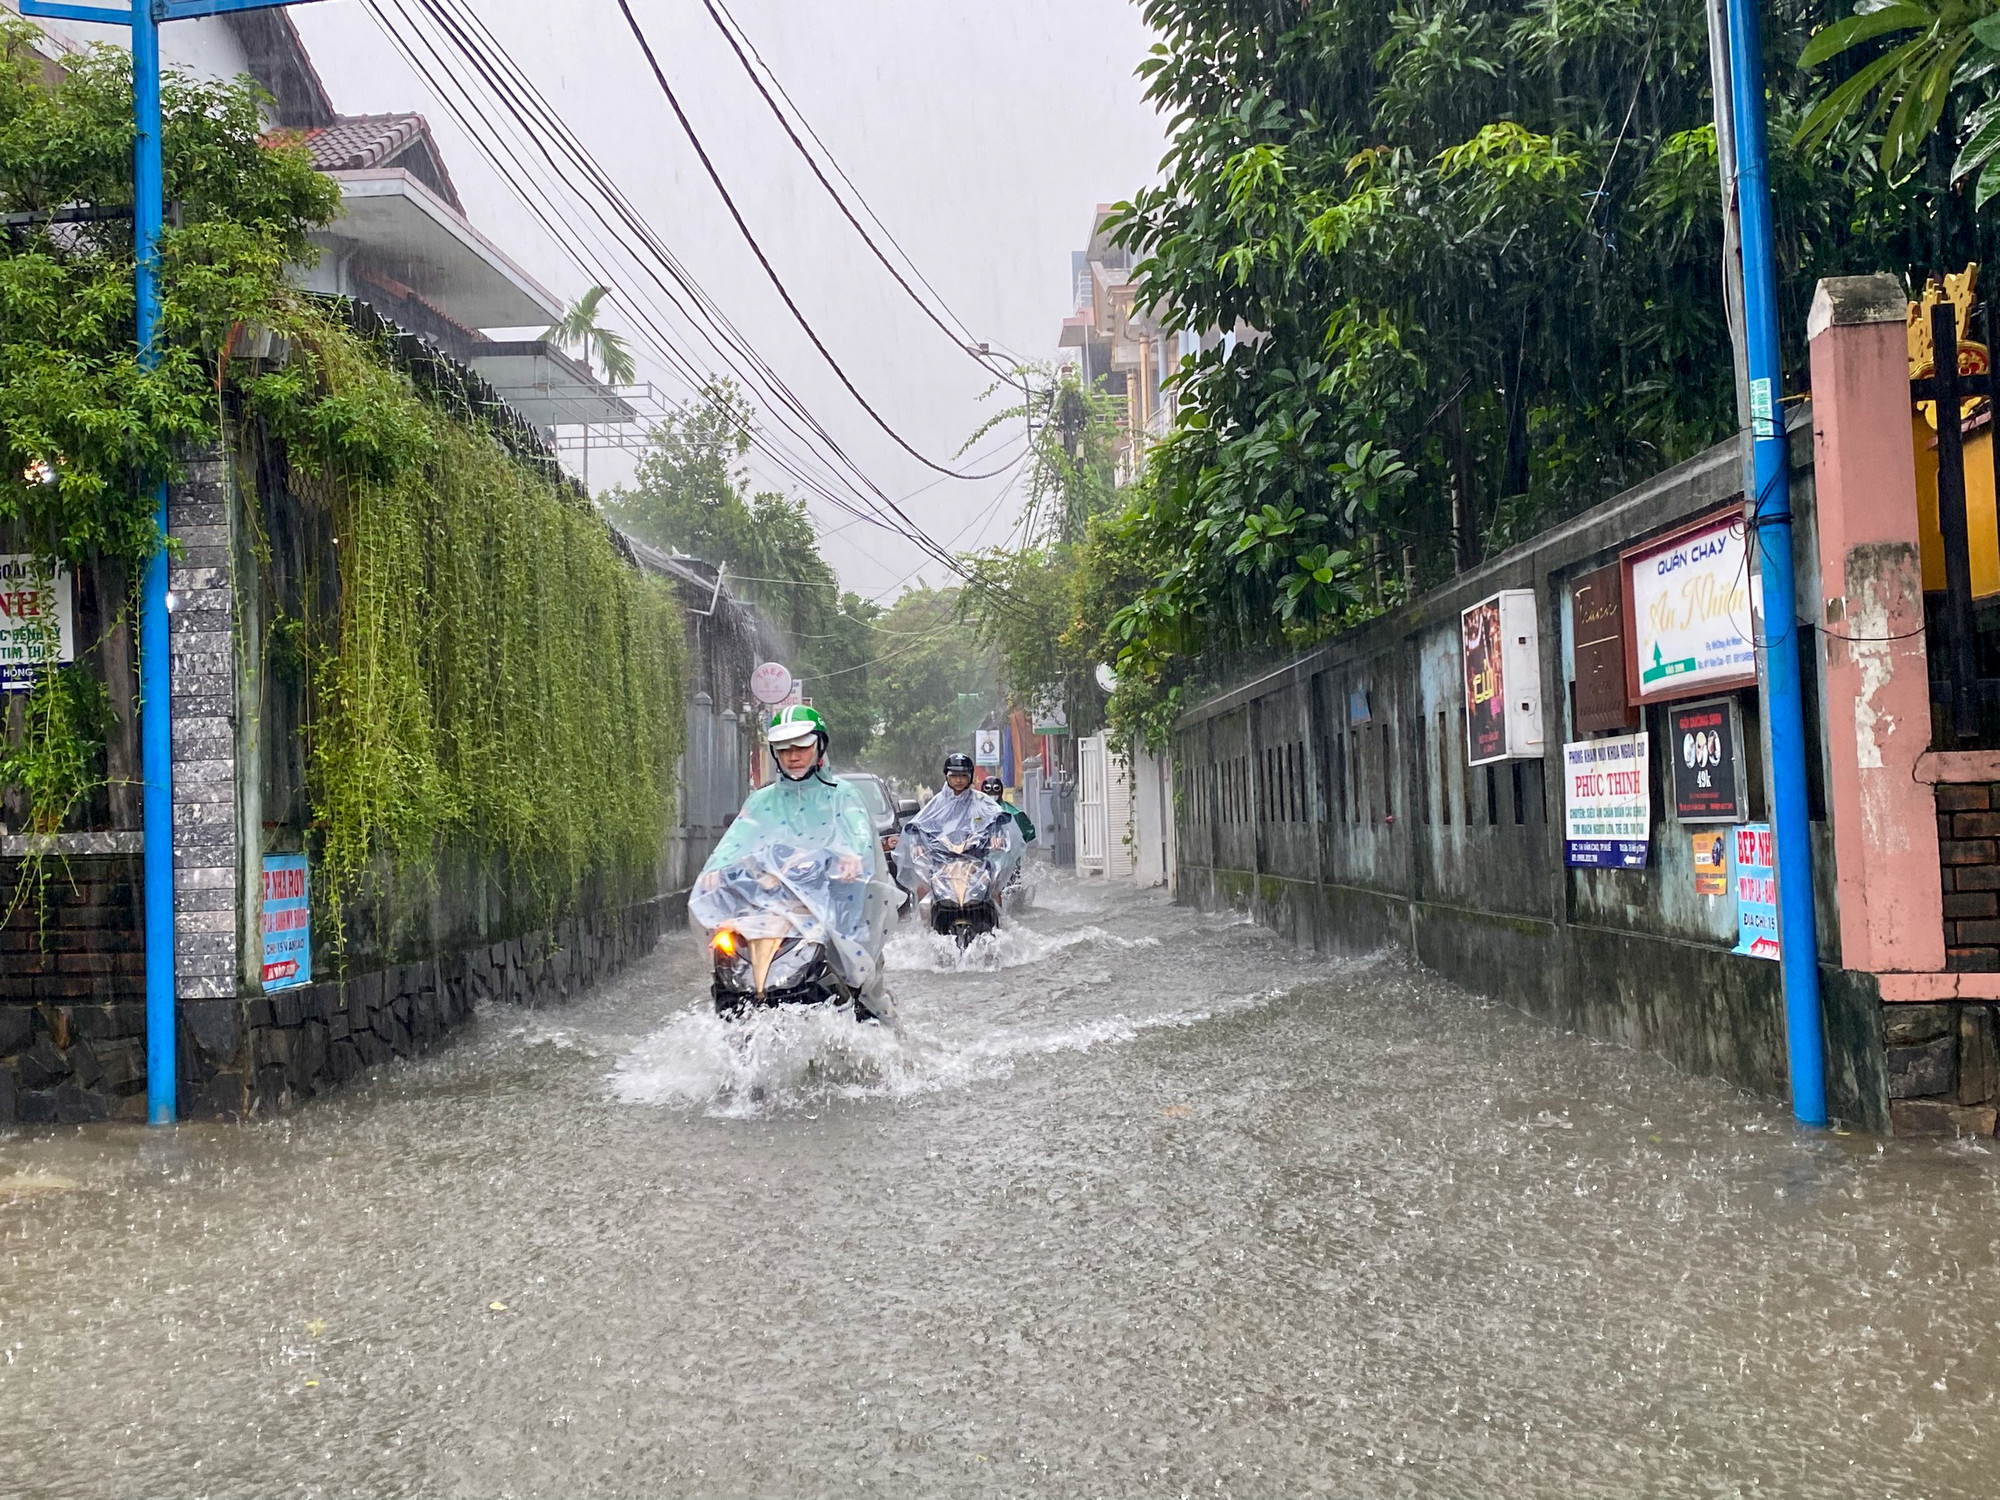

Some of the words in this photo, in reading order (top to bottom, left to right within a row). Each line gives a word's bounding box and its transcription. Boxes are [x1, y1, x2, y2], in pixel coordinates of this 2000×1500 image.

[1657, 549, 1688, 576] QUÁN
[1691, 535, 1727, 563] CHAY
[1575, 768, 1604, 797] PHÚC
[1607, 771, 1640, 801] THỊNH
